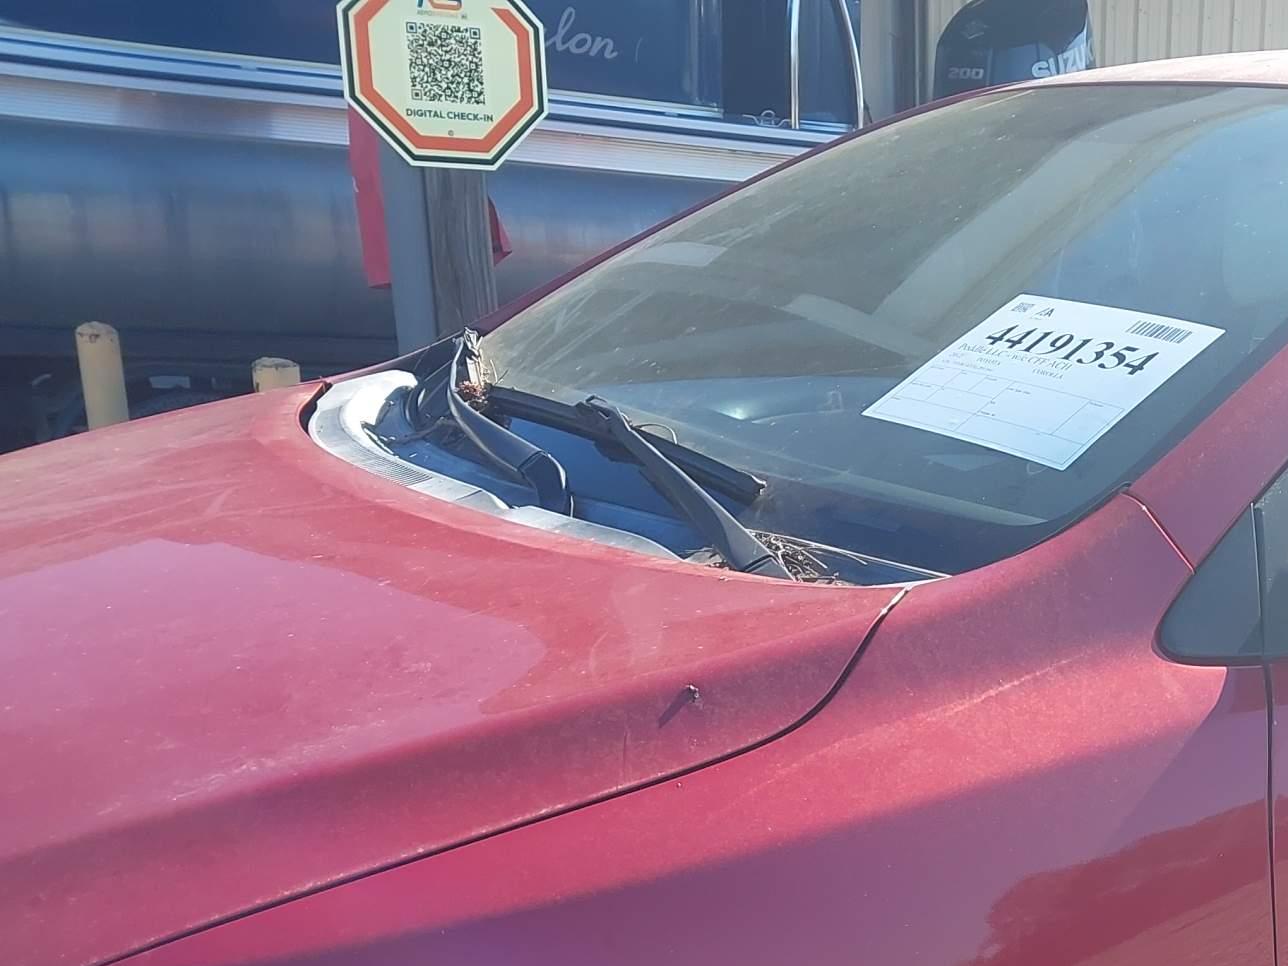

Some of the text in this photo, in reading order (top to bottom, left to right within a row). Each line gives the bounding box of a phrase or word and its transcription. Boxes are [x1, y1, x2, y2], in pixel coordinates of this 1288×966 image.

[544, 6, 619, 59] lon
[948, 67, 985, 80] 200
[405, 108, 494, 122] DIGITAL CHECK-IN
[985, 324, 1160, 376] 44191354
